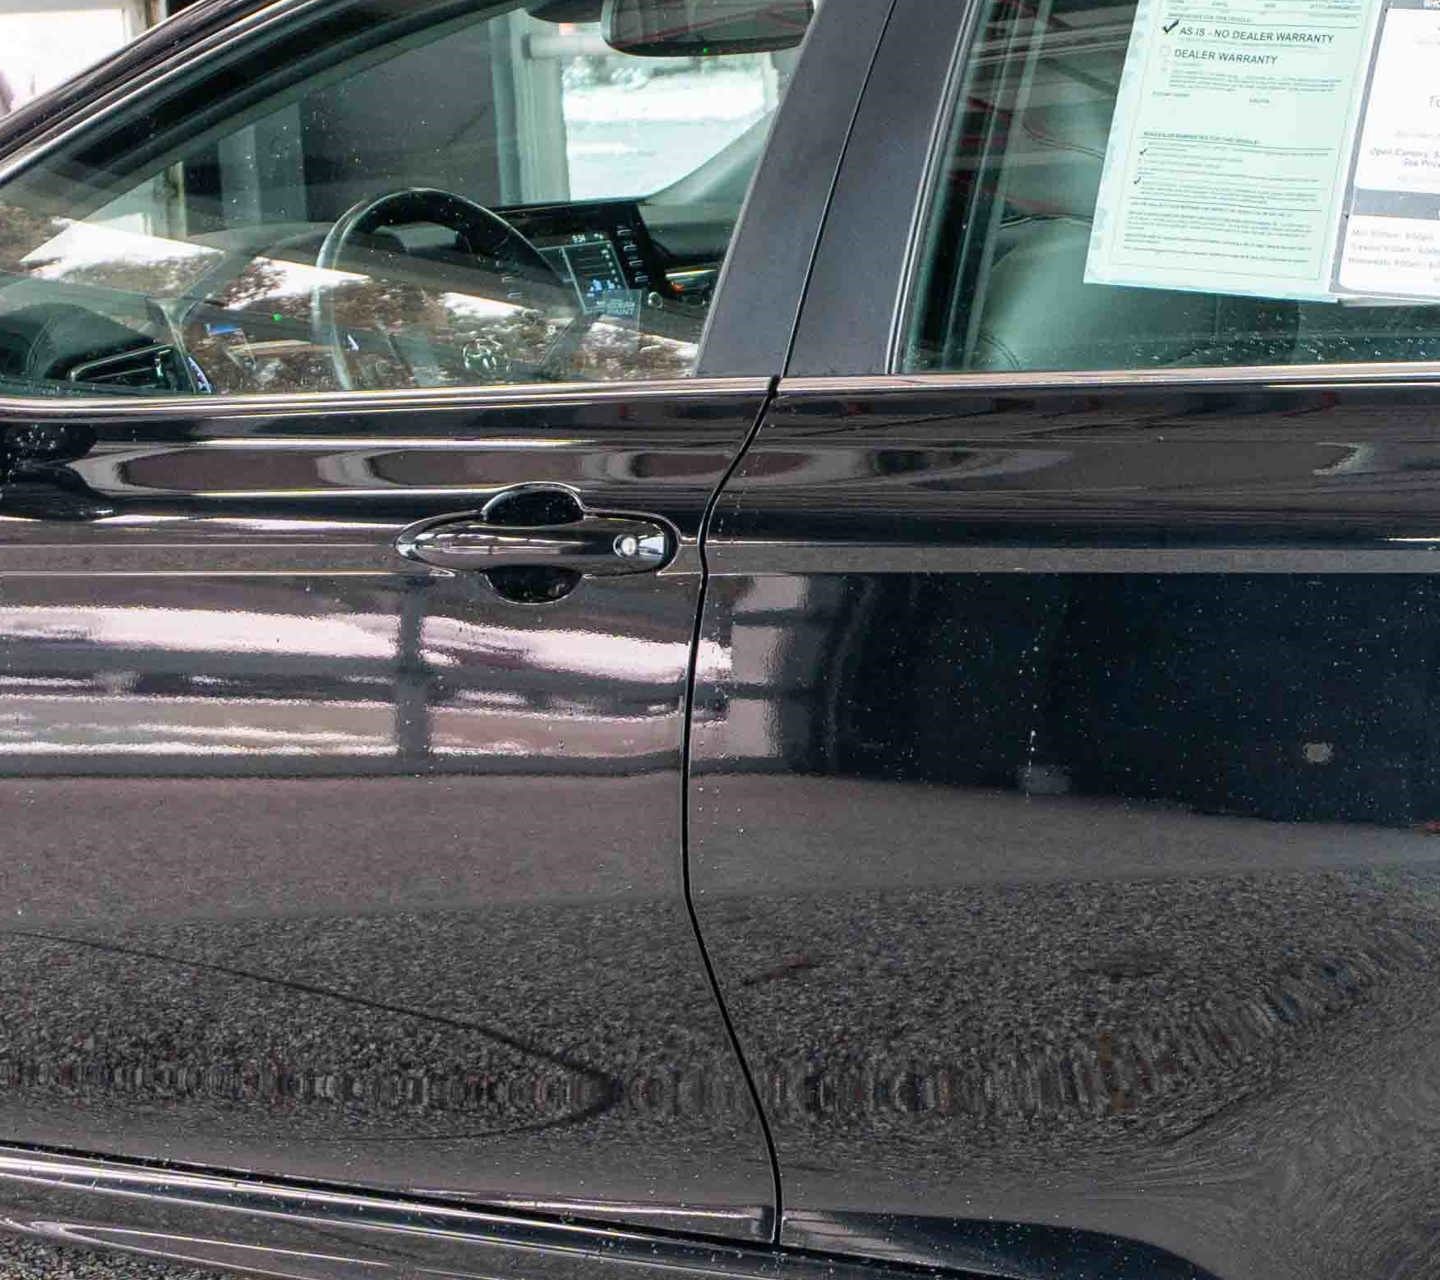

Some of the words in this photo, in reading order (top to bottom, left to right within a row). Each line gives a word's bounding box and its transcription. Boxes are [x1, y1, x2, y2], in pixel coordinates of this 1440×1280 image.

[1179, 26, 1193, 36] AS
[1194, 27, 1206, 37] IS
[1213, 28, 1230, 38] NO
[1231, 29, 1274, 41] DEALER
[1275, 31, 1335, 44] WARRANTY
[1173, 49, 1216, 61] DEALER
[1218, 52, 1279, 65] WARRANTY
